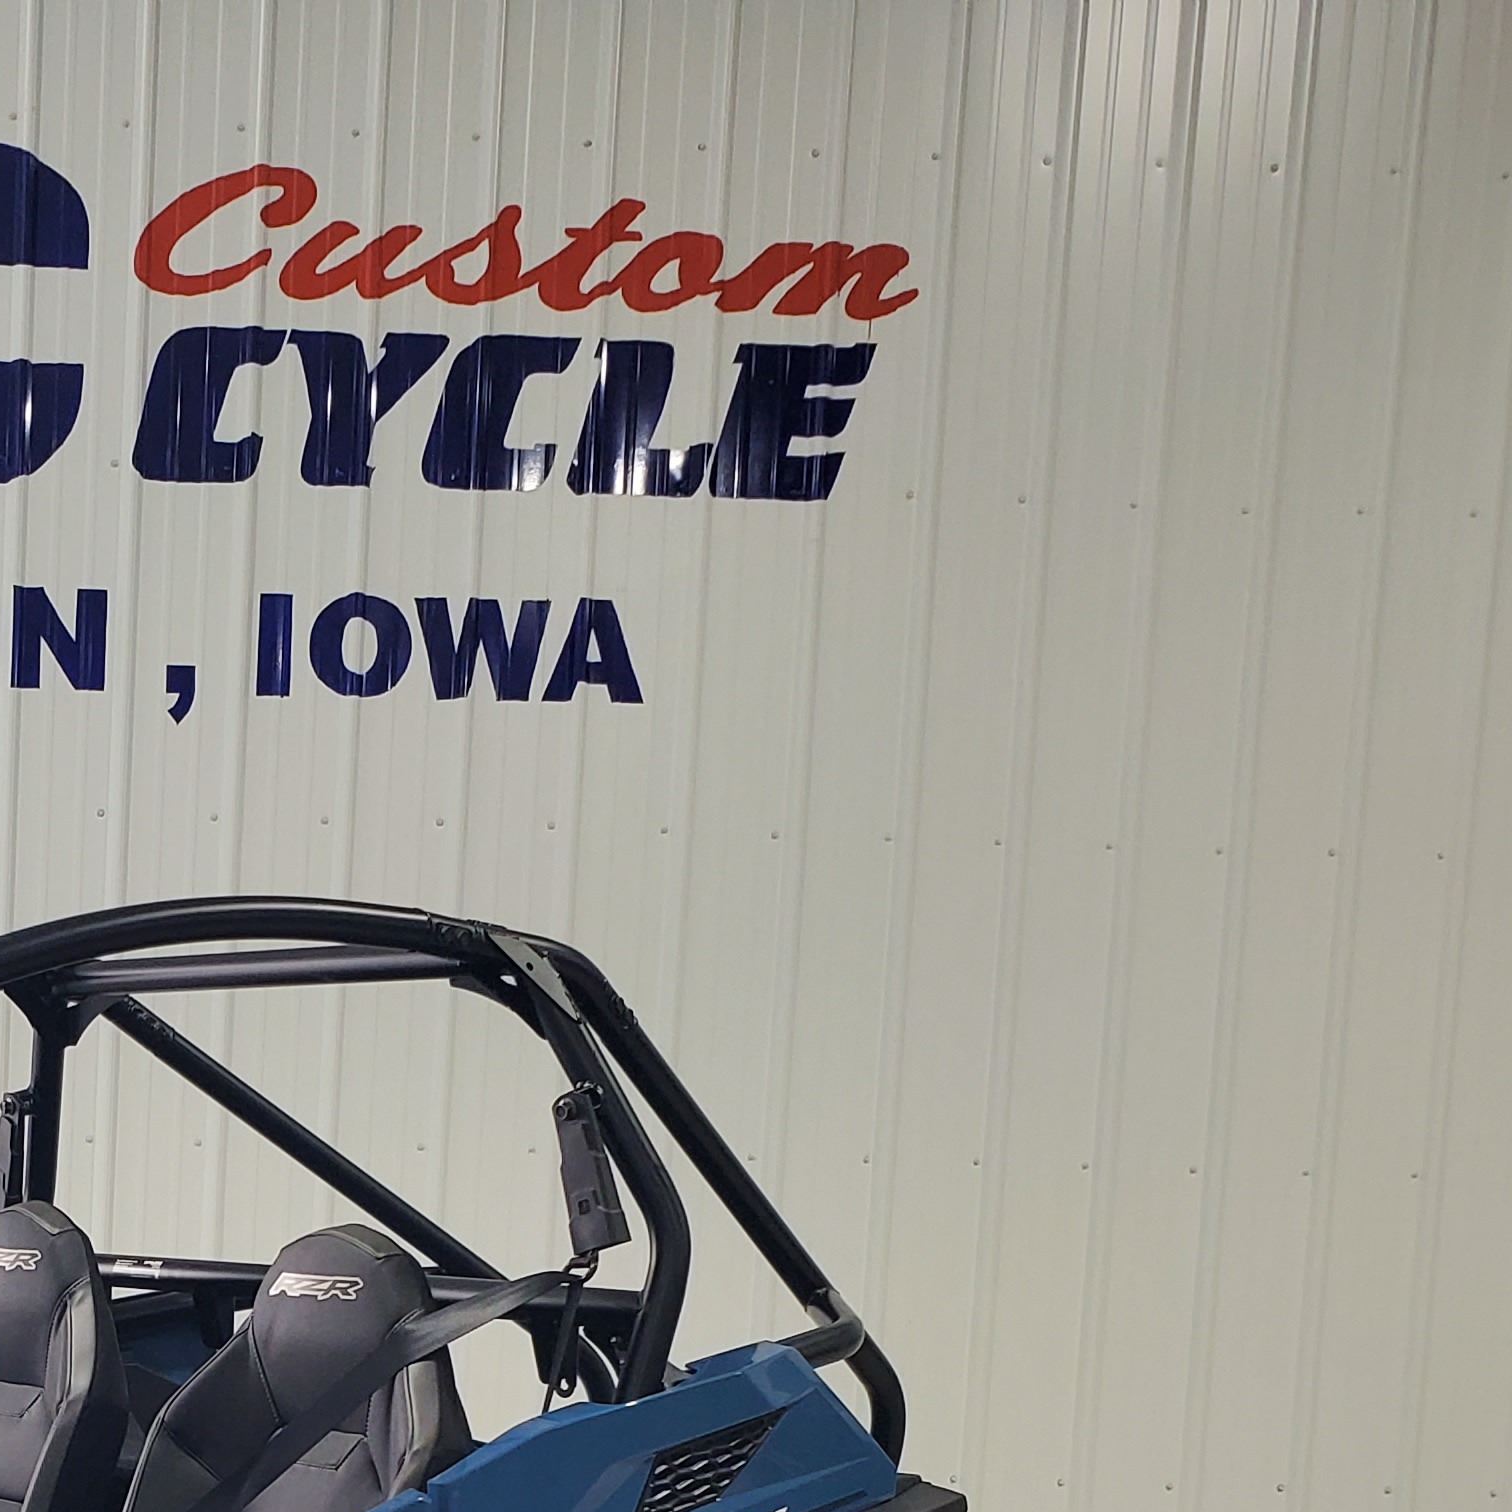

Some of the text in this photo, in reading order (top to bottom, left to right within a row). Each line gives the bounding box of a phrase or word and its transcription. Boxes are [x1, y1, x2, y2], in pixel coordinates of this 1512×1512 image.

[133, 164, 919, 321] Custom
[131, 326, 877, 501] CYCLE
[255, 591, 644, 704] IOWA
[269, 1272, 364, 1300] RZR
